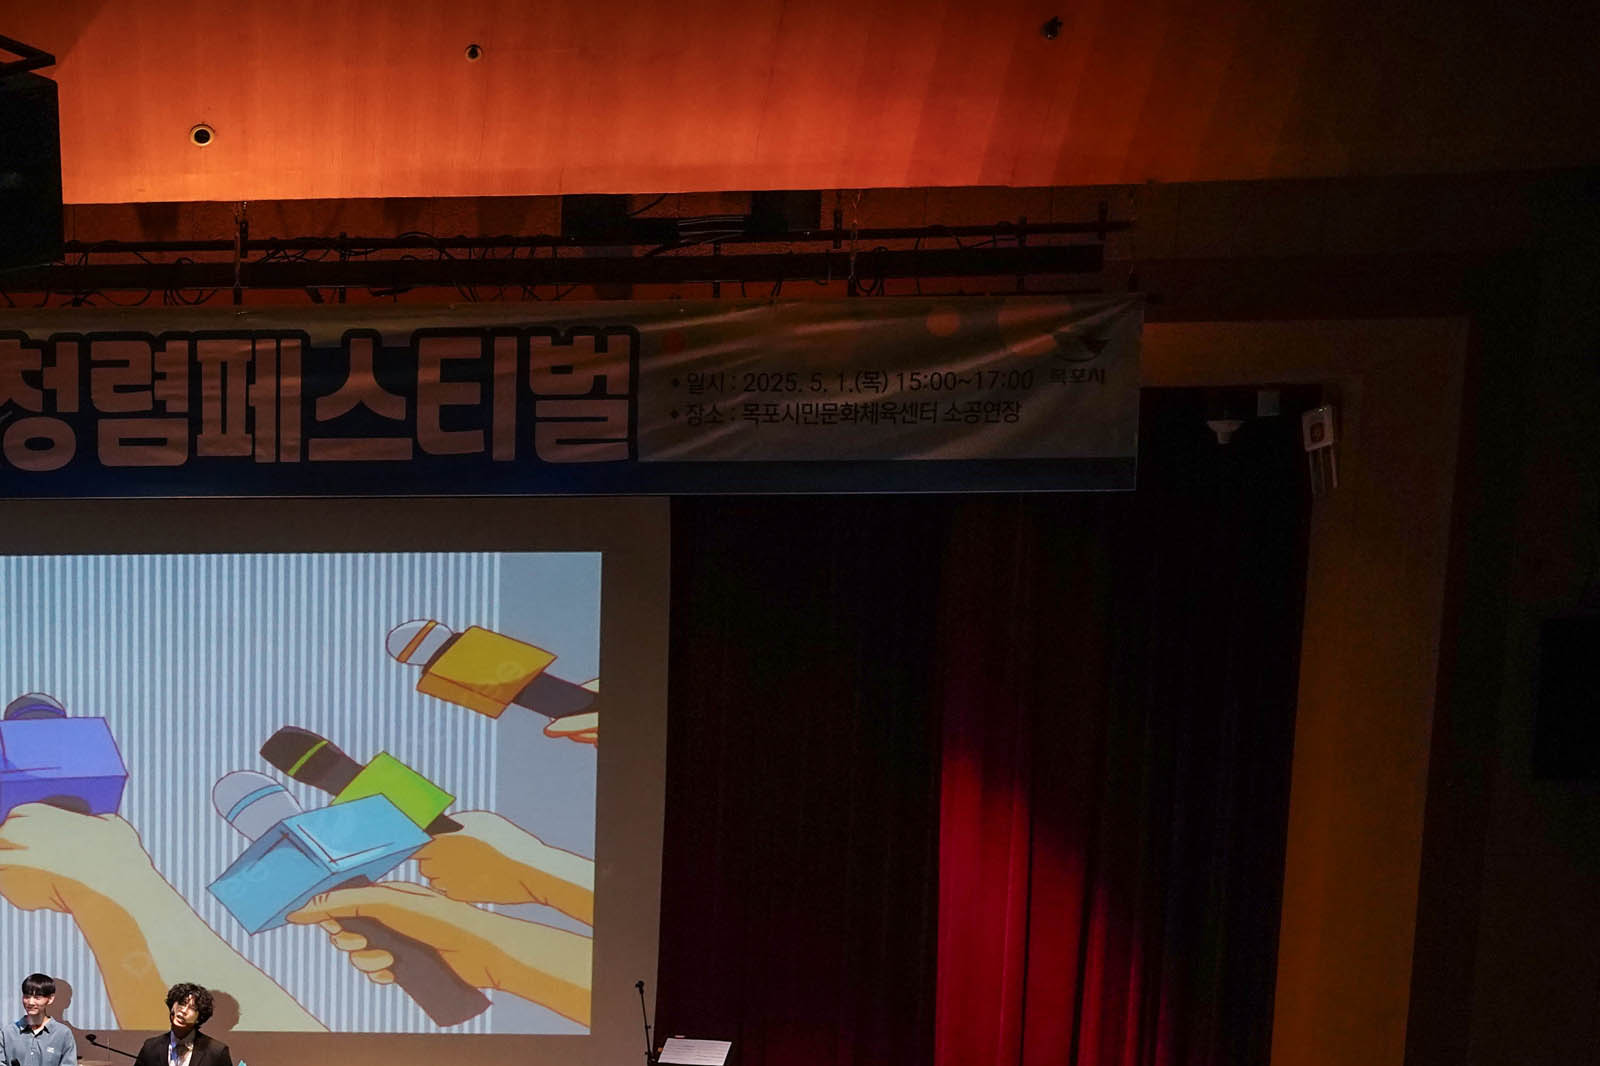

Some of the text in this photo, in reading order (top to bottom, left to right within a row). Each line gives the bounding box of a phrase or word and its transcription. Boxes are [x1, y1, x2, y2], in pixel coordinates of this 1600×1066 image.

[686, 372, 726, 393] 일시
[896, 369, 1033, 392] 15:00~17:00
[686, 405, 725, 426] 장소
[742, 401, 938, 425] 목포시민문화체육센터
[944, 401, 1021, 425] 소공연장
